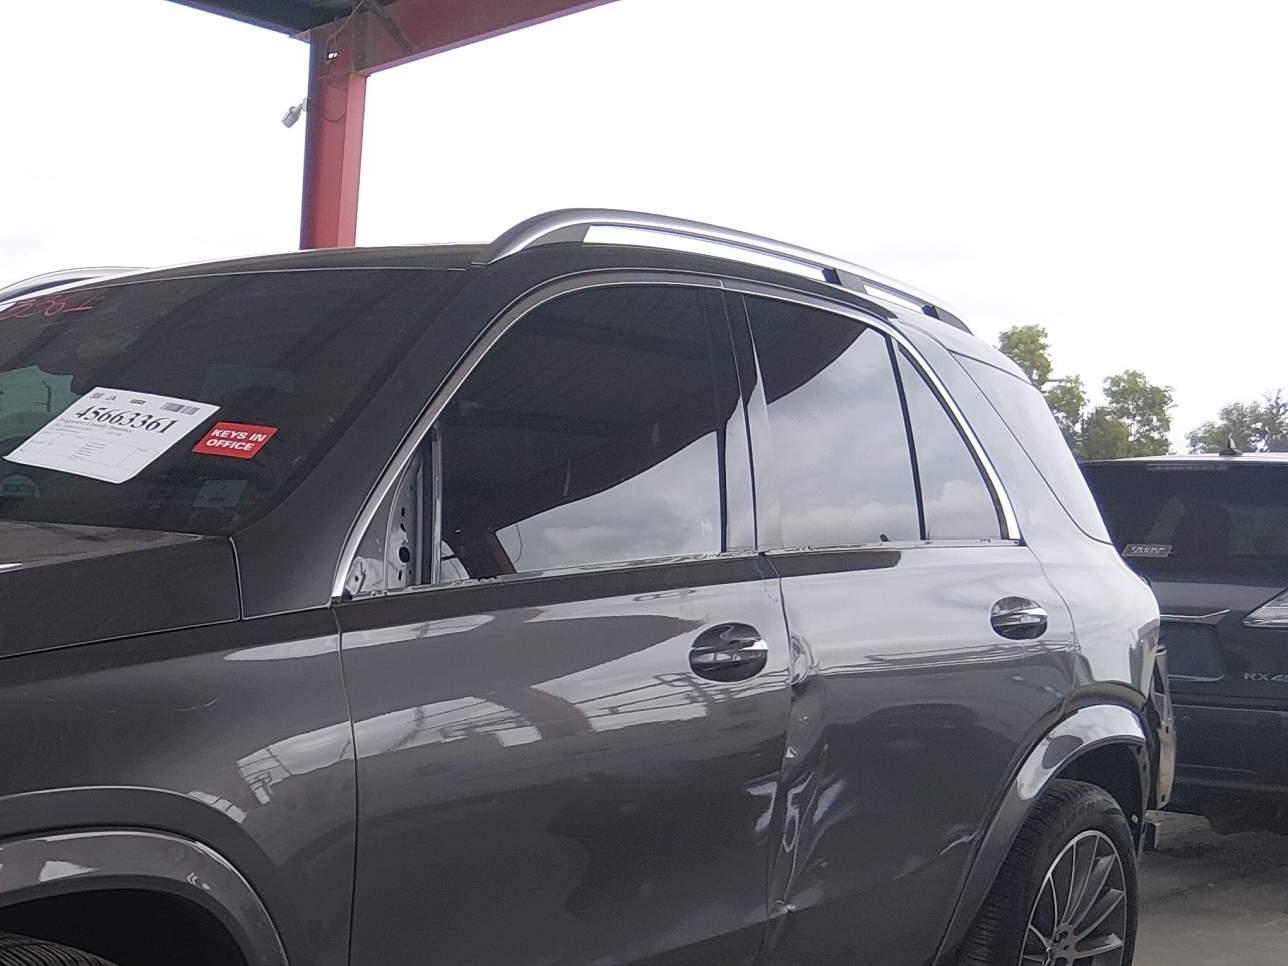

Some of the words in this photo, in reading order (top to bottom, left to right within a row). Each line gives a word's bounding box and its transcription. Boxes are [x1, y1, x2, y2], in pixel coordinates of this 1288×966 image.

[75, 405, 178, 433] 45663361
[210, 429, 248, 440] KEYS
[249, 432, 267, 442] IN
[206, 438, 255, 451] OFFICE
